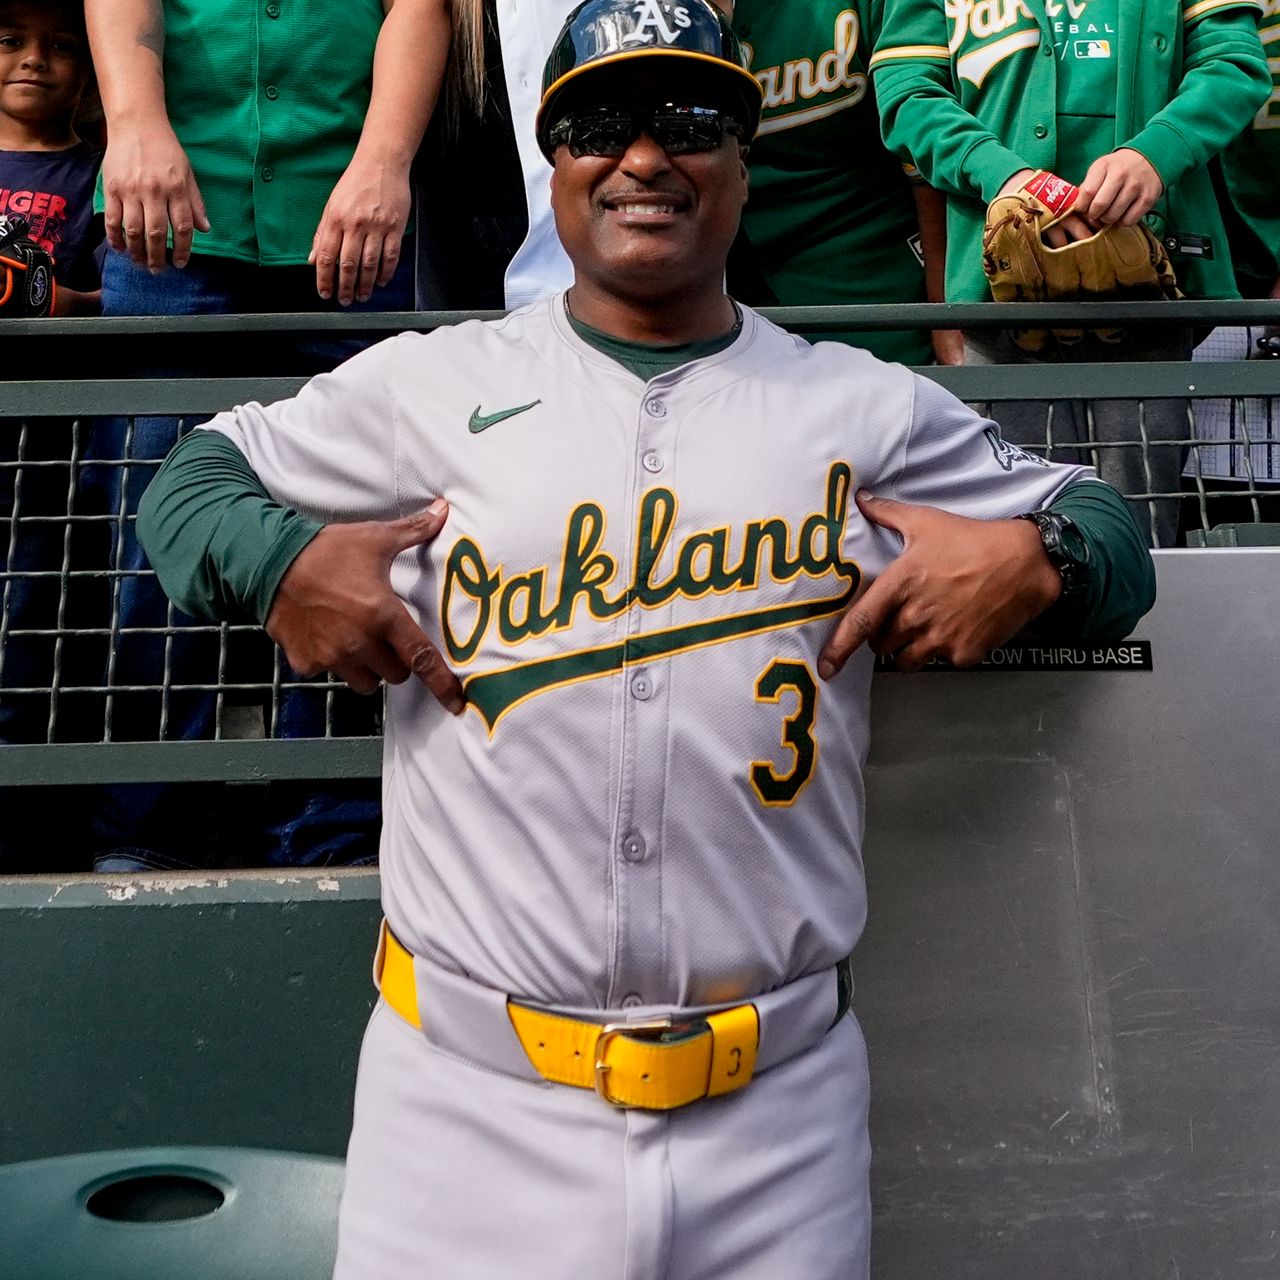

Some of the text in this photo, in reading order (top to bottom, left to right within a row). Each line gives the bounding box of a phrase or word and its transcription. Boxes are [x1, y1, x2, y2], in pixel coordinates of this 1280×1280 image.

[440, 460, 862, 666] Oakland
[1027, 647, 1087, 665] THIRD
[1091, 646, 1144, 665] BASE
[748, 657, 820, 808] 3
[727, 1046, 741, 1078] 3
